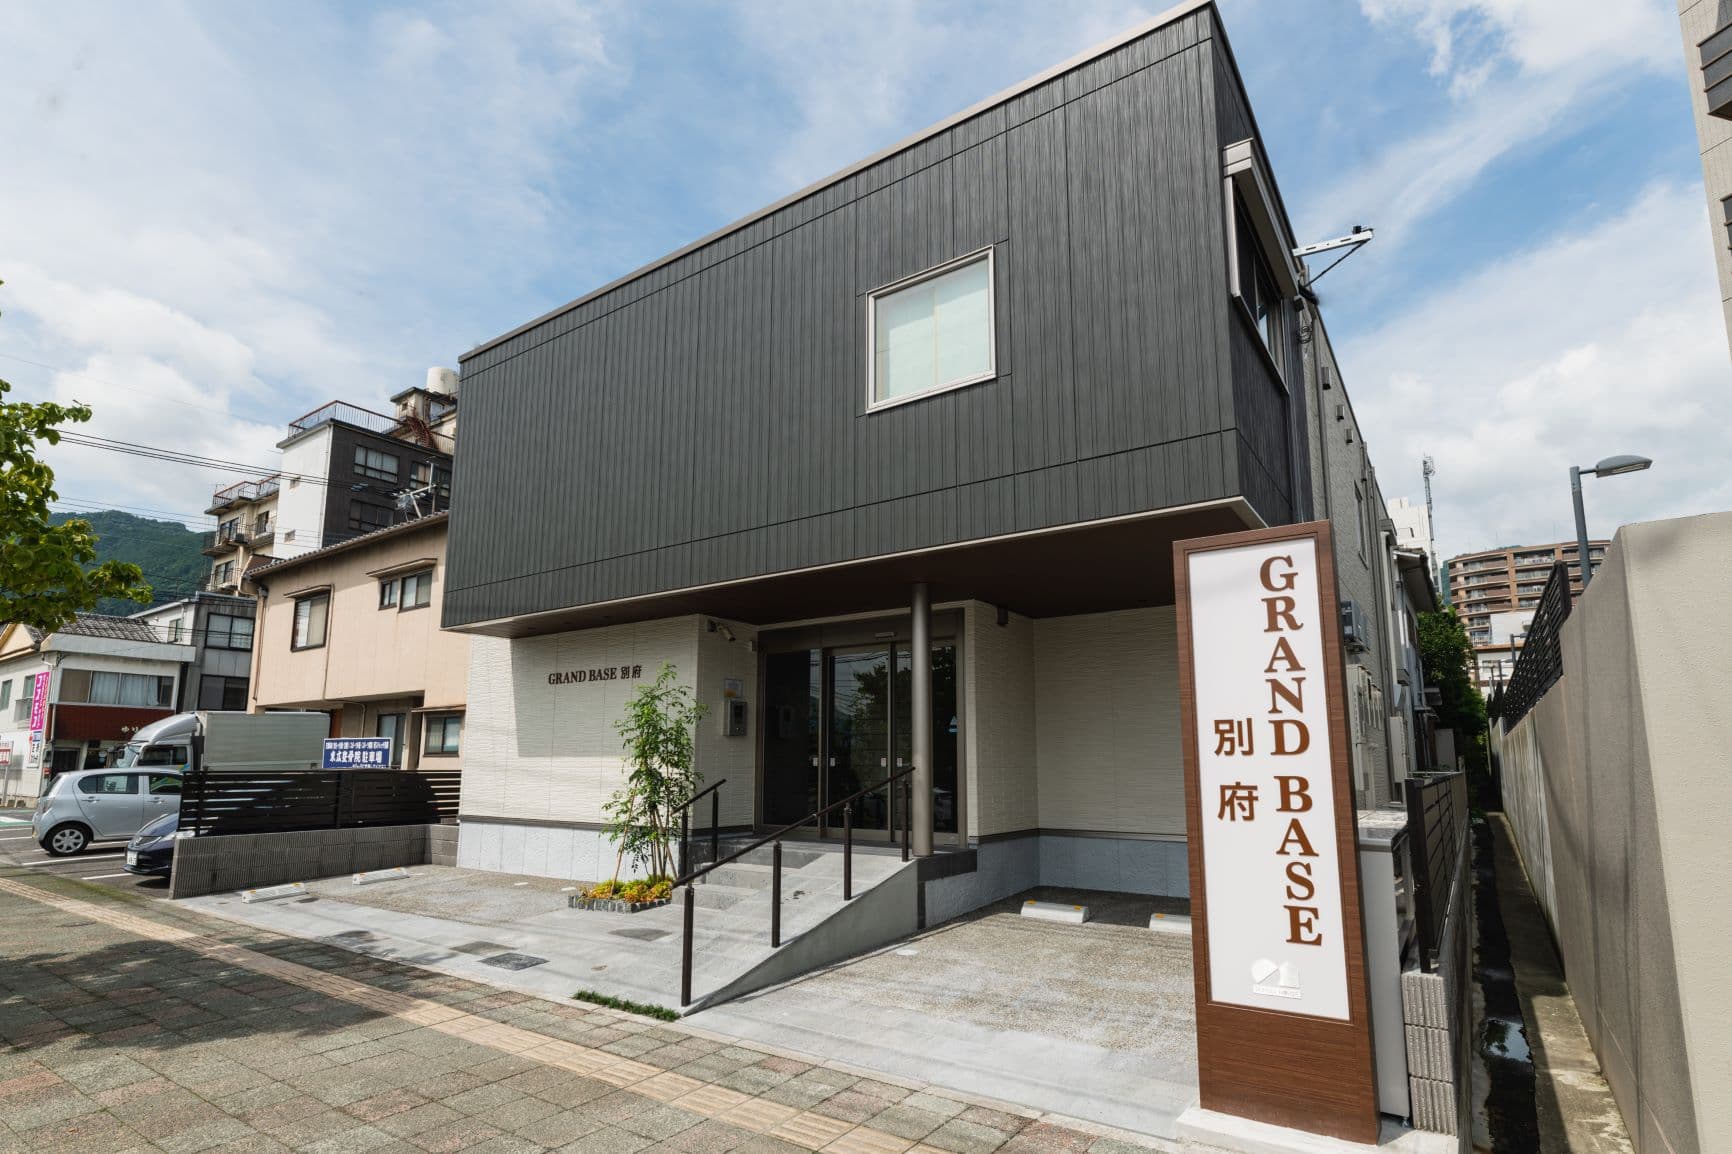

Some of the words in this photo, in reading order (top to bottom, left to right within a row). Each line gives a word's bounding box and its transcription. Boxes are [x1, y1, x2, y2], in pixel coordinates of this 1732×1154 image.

[548, 670, 586, 685] GRAND
[588, 667, 617, 681] BASE
[620, 664, 642, 679] 別府
[1259, 555, 1310, 756] GRAND
[1214, 717, 1258, 822] 別府
[1273, 775, 1322, 946] BASE
